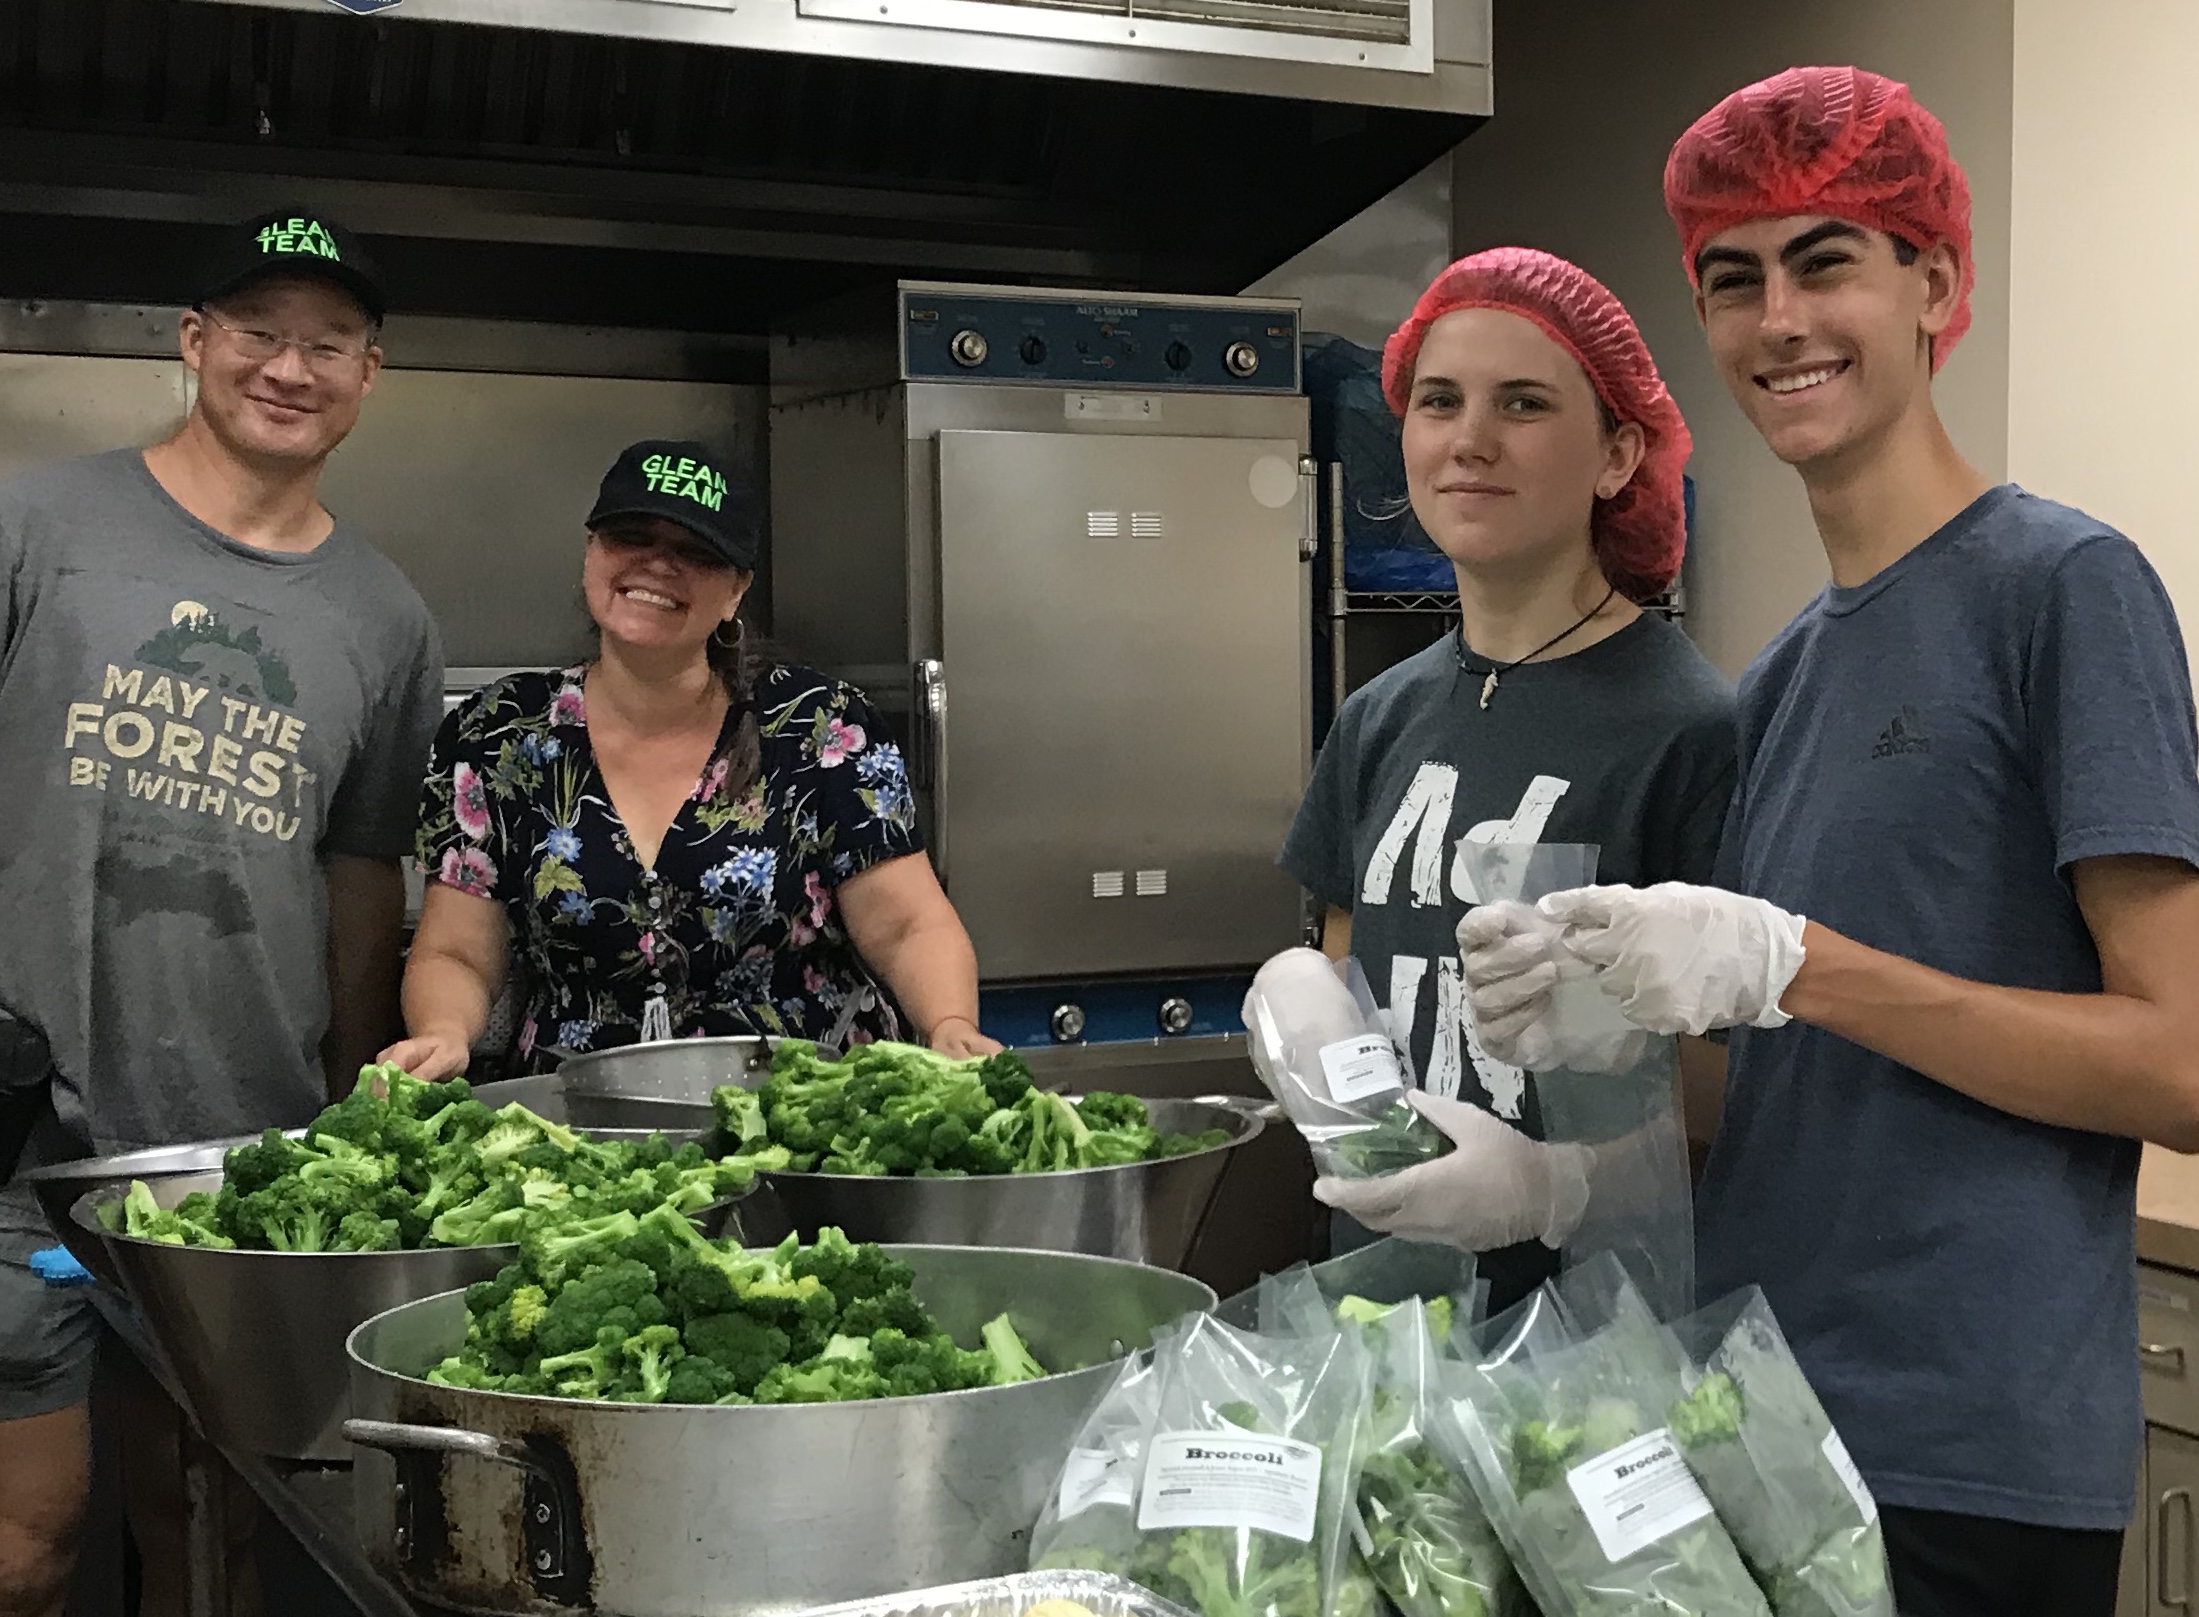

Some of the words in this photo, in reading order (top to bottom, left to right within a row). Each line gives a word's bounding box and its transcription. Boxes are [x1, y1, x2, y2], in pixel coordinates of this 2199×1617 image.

[256, 234, 340, 262] TEAM
[646, 473, 722, 512] TEAM
[102, 663, 209, 719] MAY
[220, 695, 306, 754] THE
[64, 702, 317, 808] FOREST
[69, 756, 112, 790] BE
[127, 767, 228, 817] WITH
[232, 796, 301, 841] YOU
[1185, 1448, 1284, 1465] Broccoli
